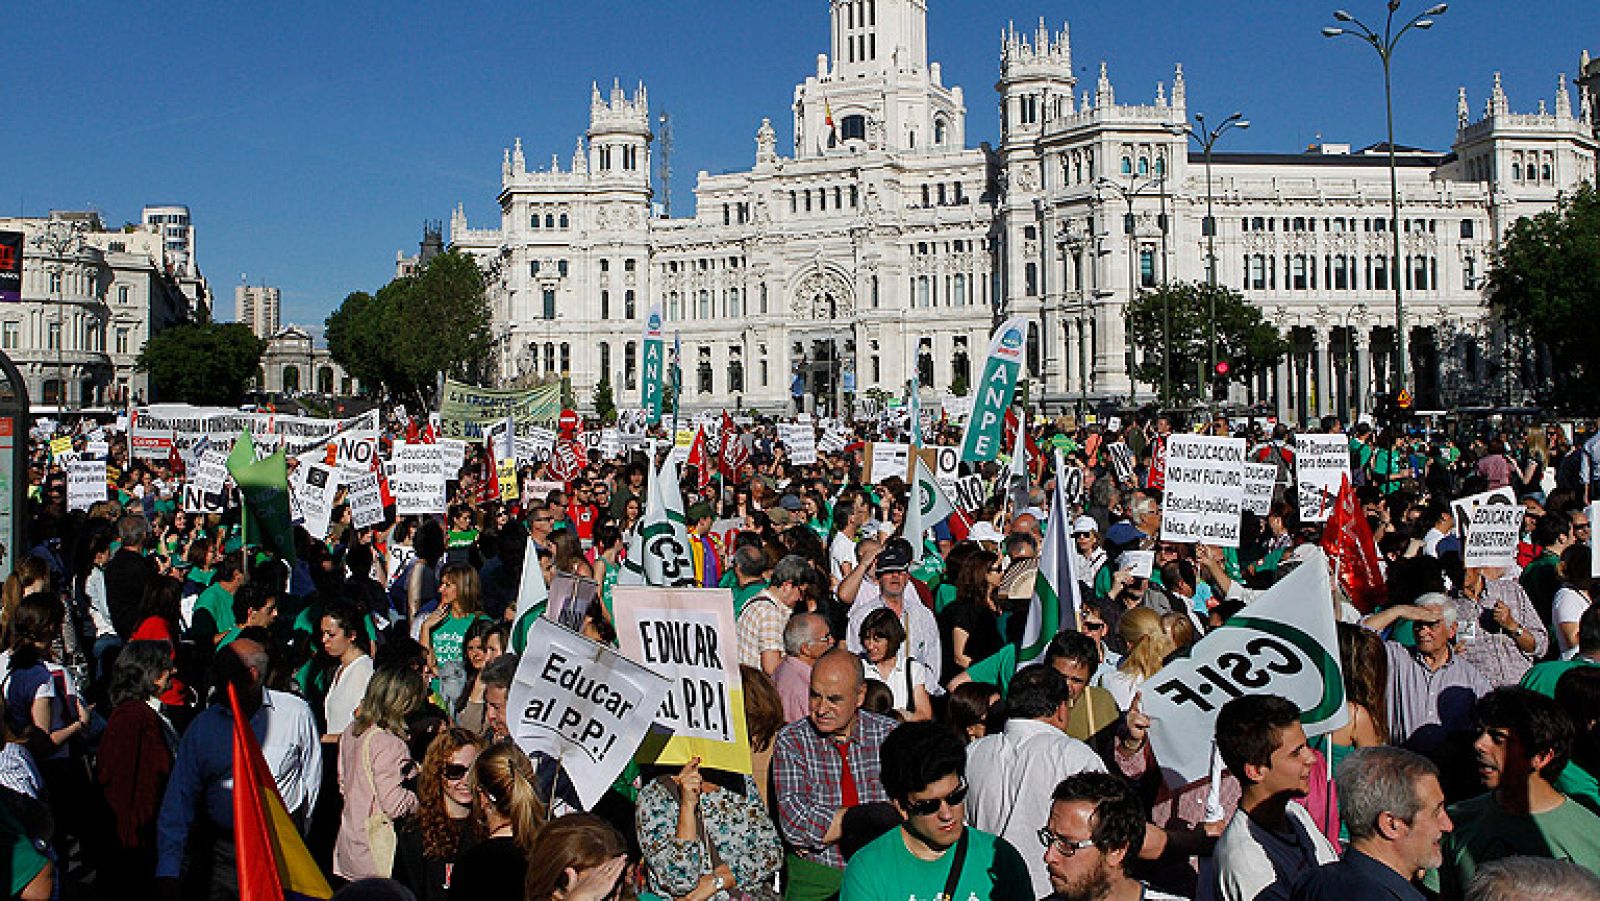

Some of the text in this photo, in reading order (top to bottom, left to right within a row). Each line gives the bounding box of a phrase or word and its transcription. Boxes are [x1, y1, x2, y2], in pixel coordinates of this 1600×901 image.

[647, 343, 658, 419] ANPE
[975, 364, 1007, 457] ANPE
[340, 437, 371, 462] NO
[1171, 441, 1186, 458] SIN
[955, 477, 985, 511] NO
[1168, 466, 1181, 482] NO
[1183, 468, 1202, 484] HAY
[1473, 508, 1513, 526] EDUCAR
[639, 620, 723, 671] EDUCAR
[541, 652, 634, 720] Educar
[524, 698, 618, 763] al P.P.!
